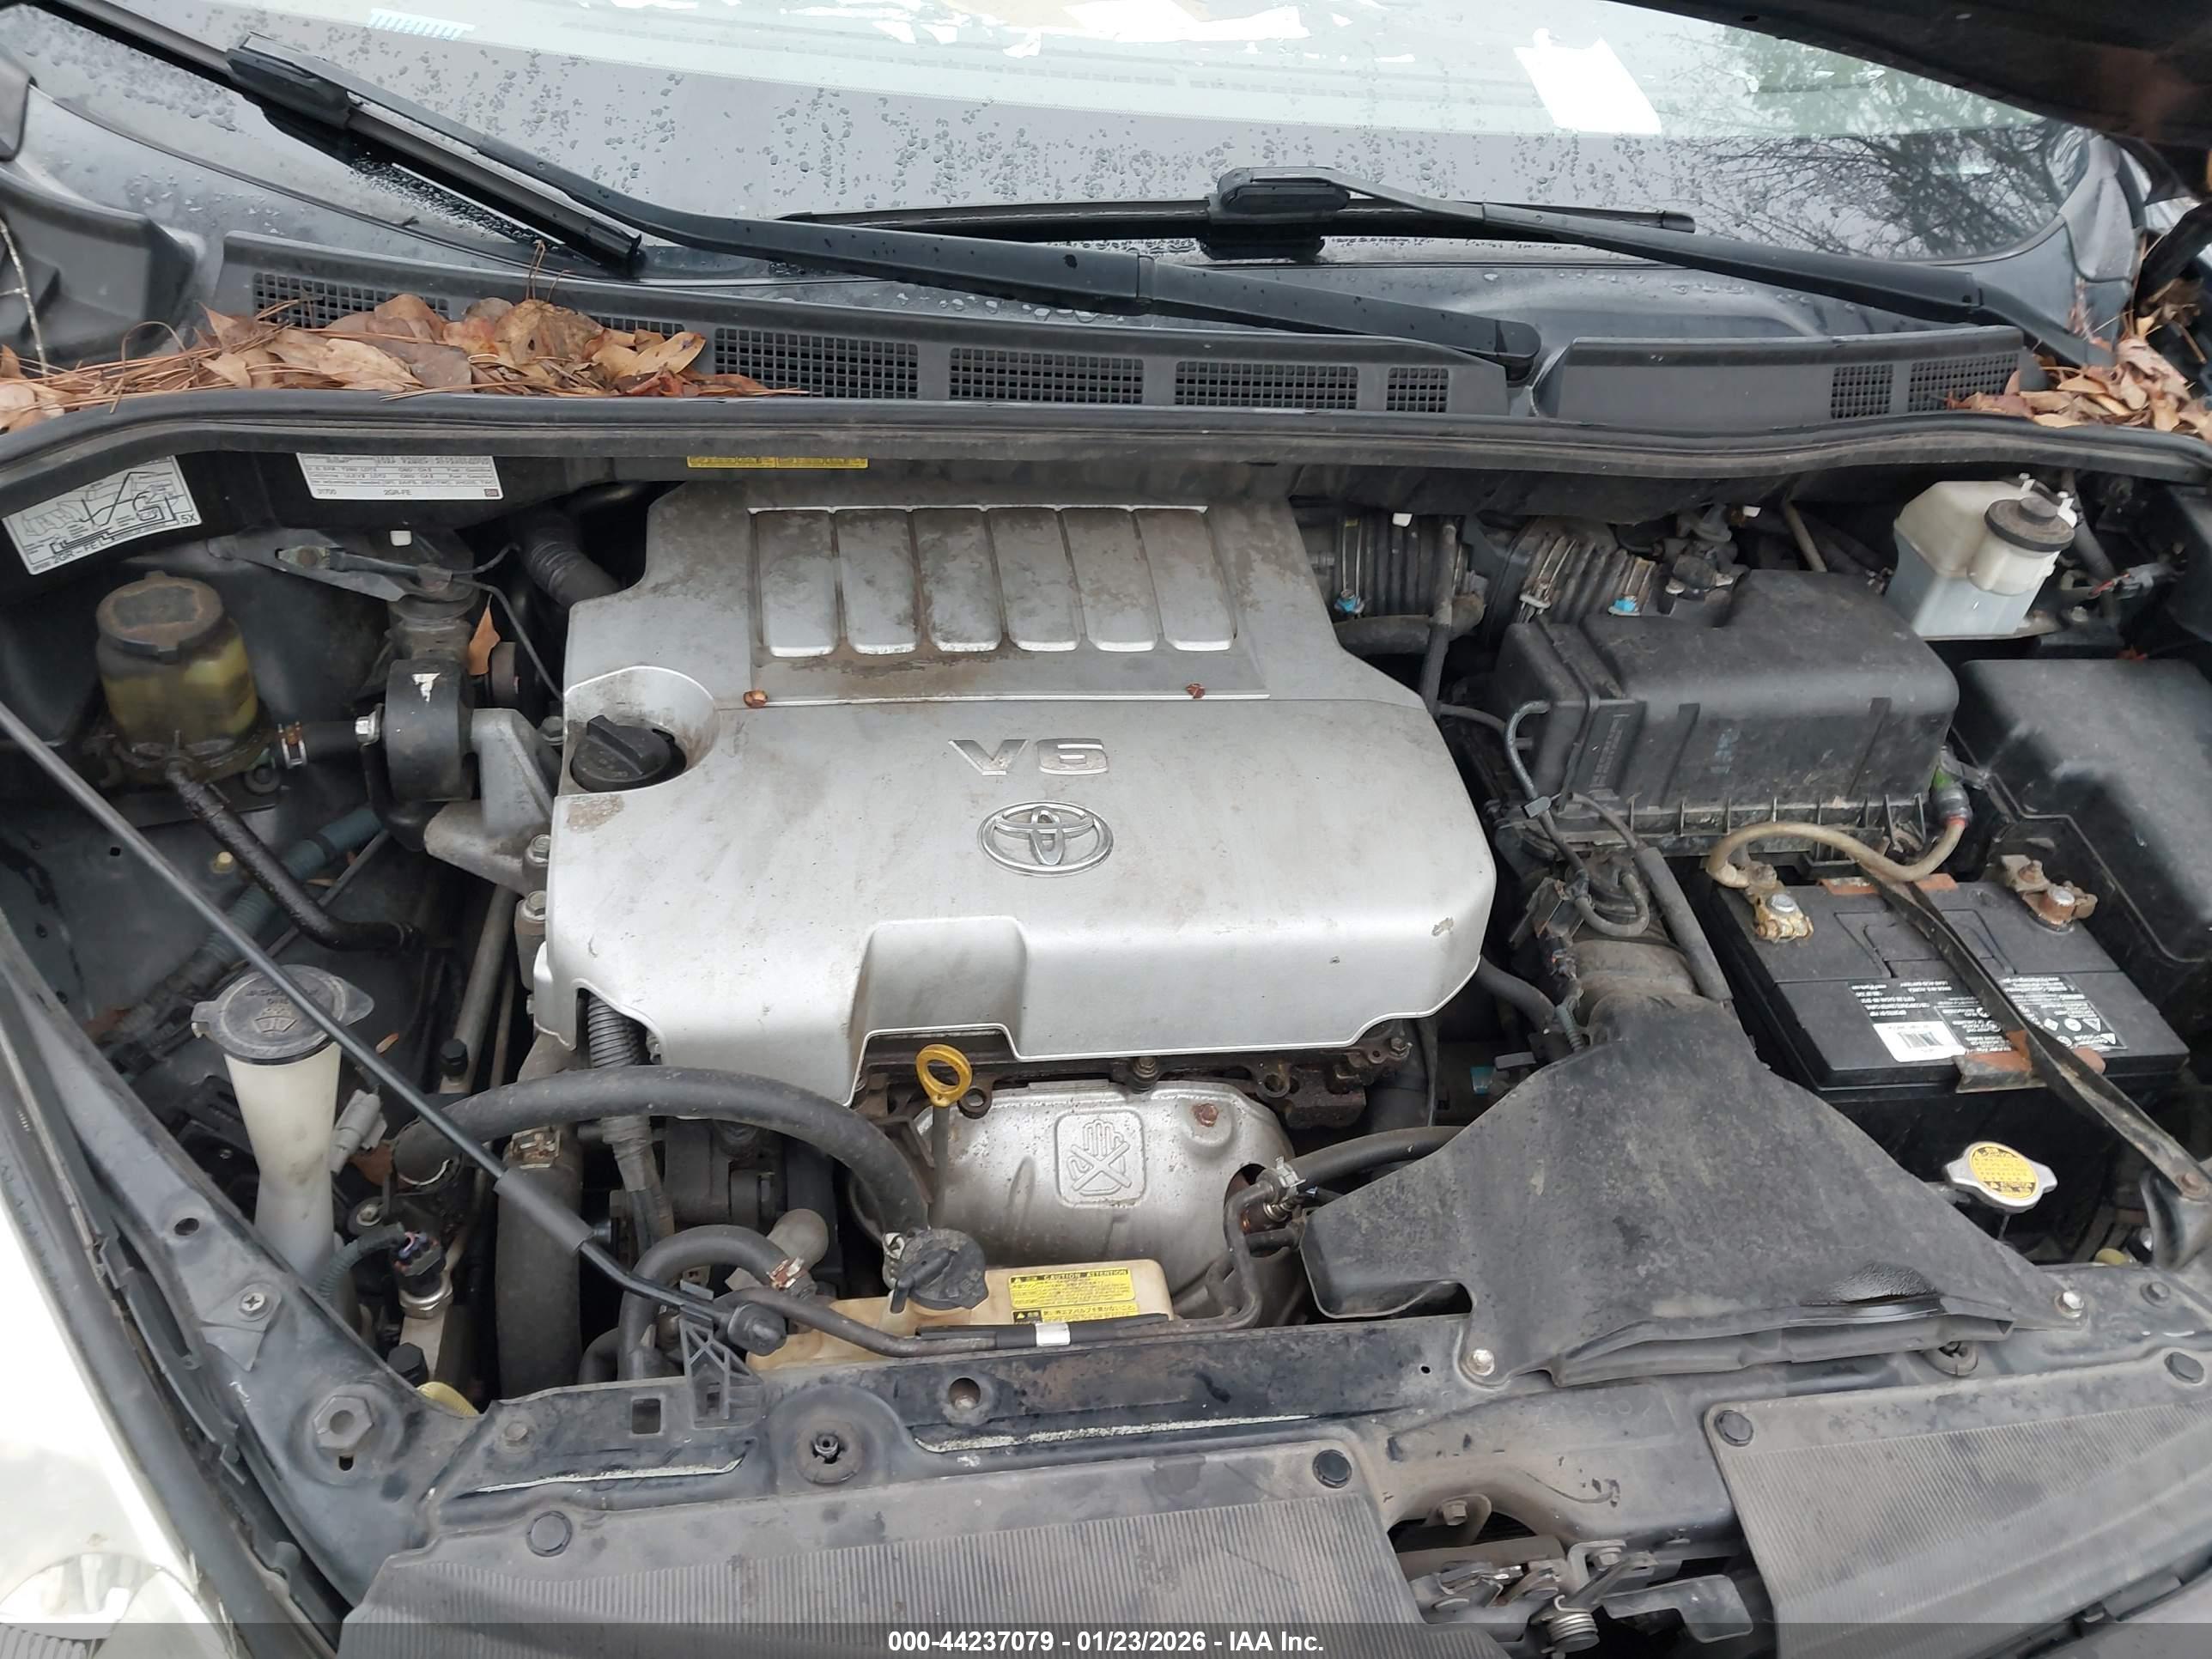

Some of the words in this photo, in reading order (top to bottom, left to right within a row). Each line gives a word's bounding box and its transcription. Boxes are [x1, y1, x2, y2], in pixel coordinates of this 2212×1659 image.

[179, 513, 199, 524] 5X
[947, 738, 1109, 776] V6
[1086, 1269, 1127, 1278] ATTENTION
